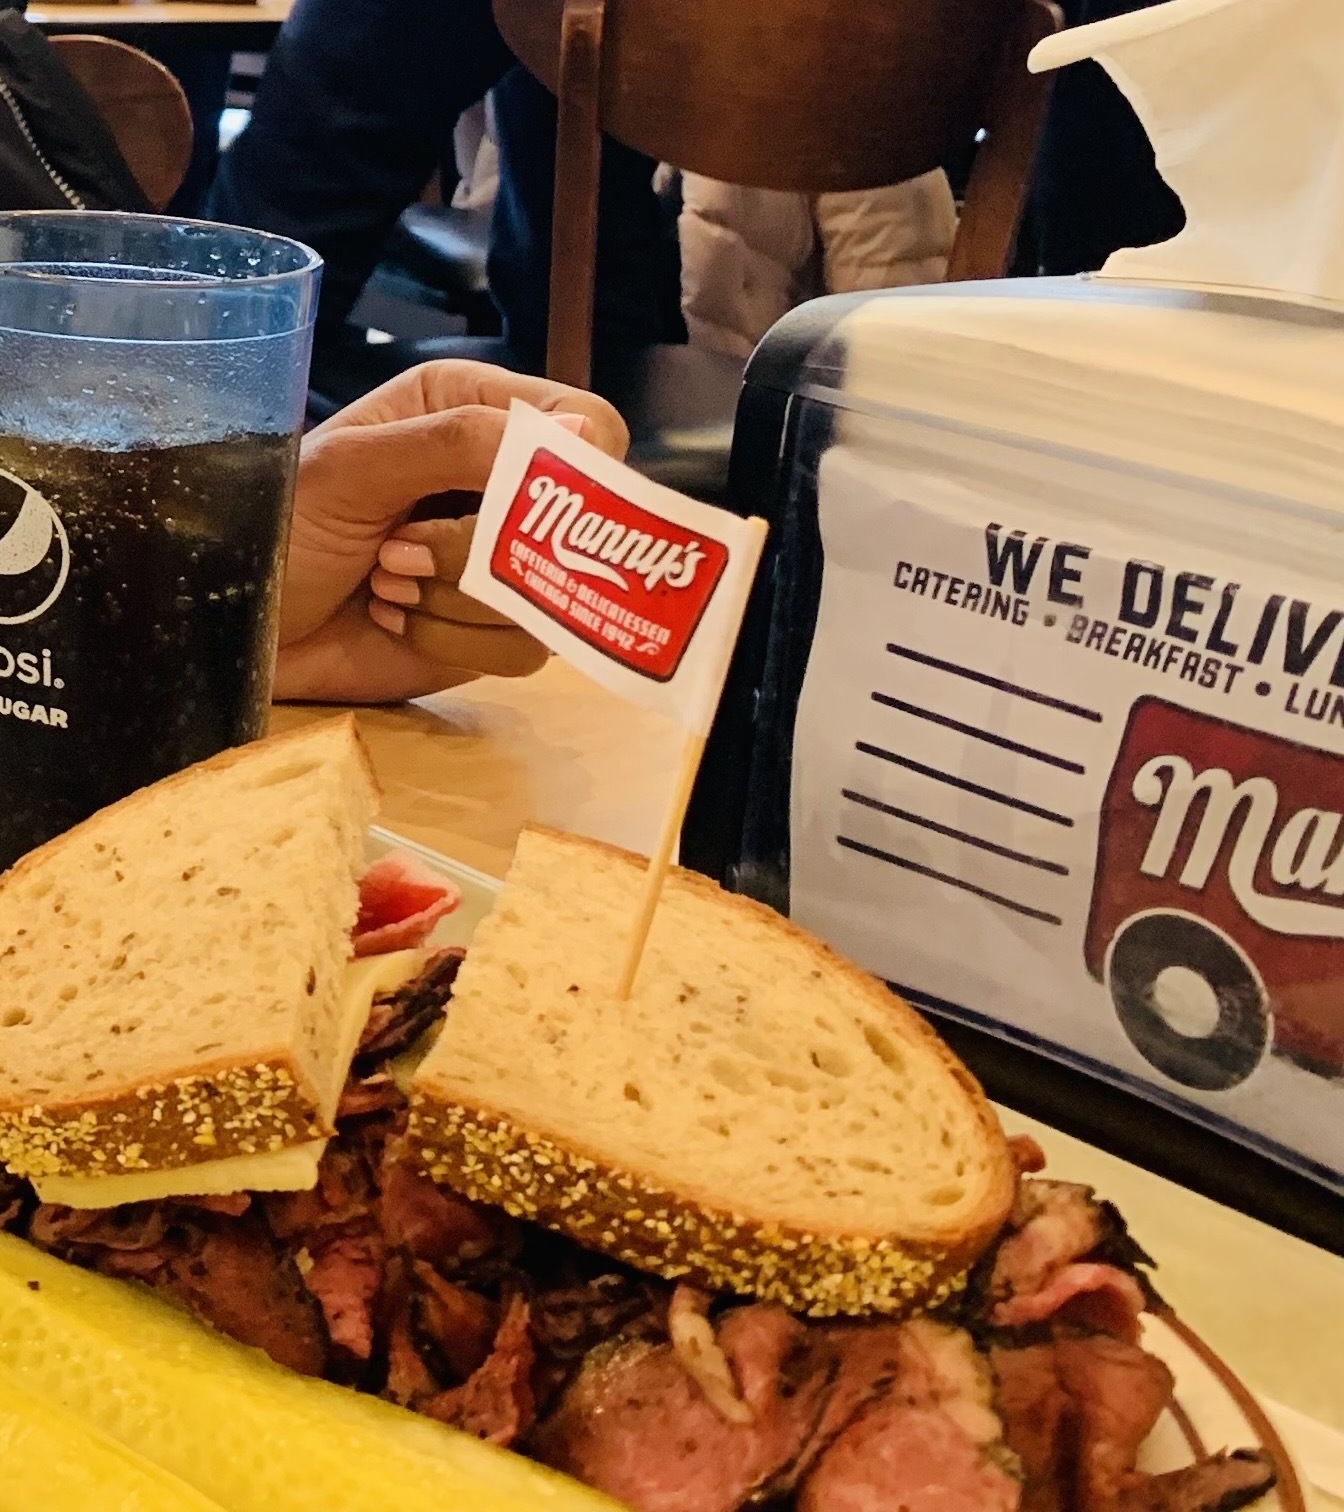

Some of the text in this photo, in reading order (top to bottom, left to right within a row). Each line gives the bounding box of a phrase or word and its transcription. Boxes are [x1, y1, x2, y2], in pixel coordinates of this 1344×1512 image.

[519, 476, 706, 592] Manny's
[985, 522, 1093, 609] WE
[510, 539, 568, 587] CAFETERIA
[576, 584, 671, 645] DELICATESSEN
[893, 561, 1030, 626] CATERING
[1066, 614, 1244, 694] BREAKFAST
